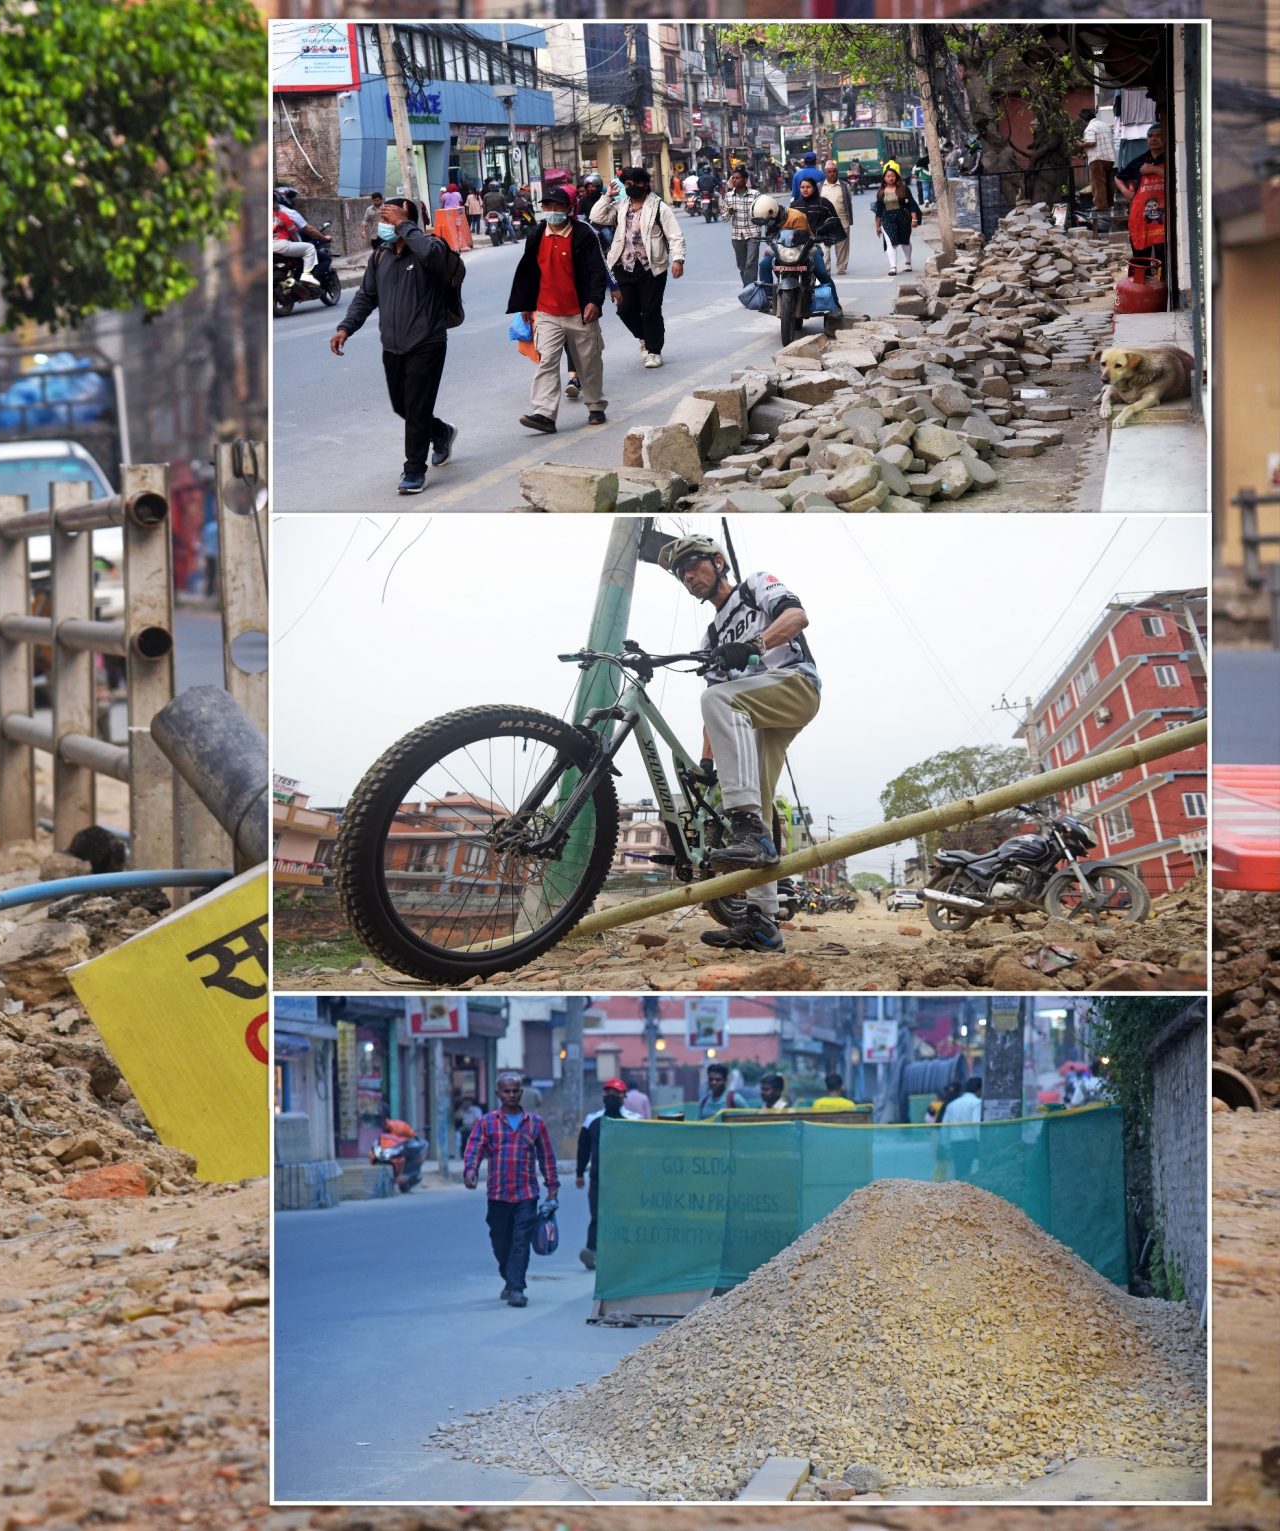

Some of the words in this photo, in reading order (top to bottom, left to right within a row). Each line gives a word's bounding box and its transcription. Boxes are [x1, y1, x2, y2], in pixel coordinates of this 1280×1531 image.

[498, 720, 563, 737] MAXXIS
[642, 737, 675, 813] SPECIALIZED
[662, 1156, 684, 1174] GO
[692, 1156, 737, 1176] SLOW
[640, 1191, 685, 1210] WORK
[688, 1192, 704, 1211] IN
[708, 1193, 780, 1213] PROGRESS
